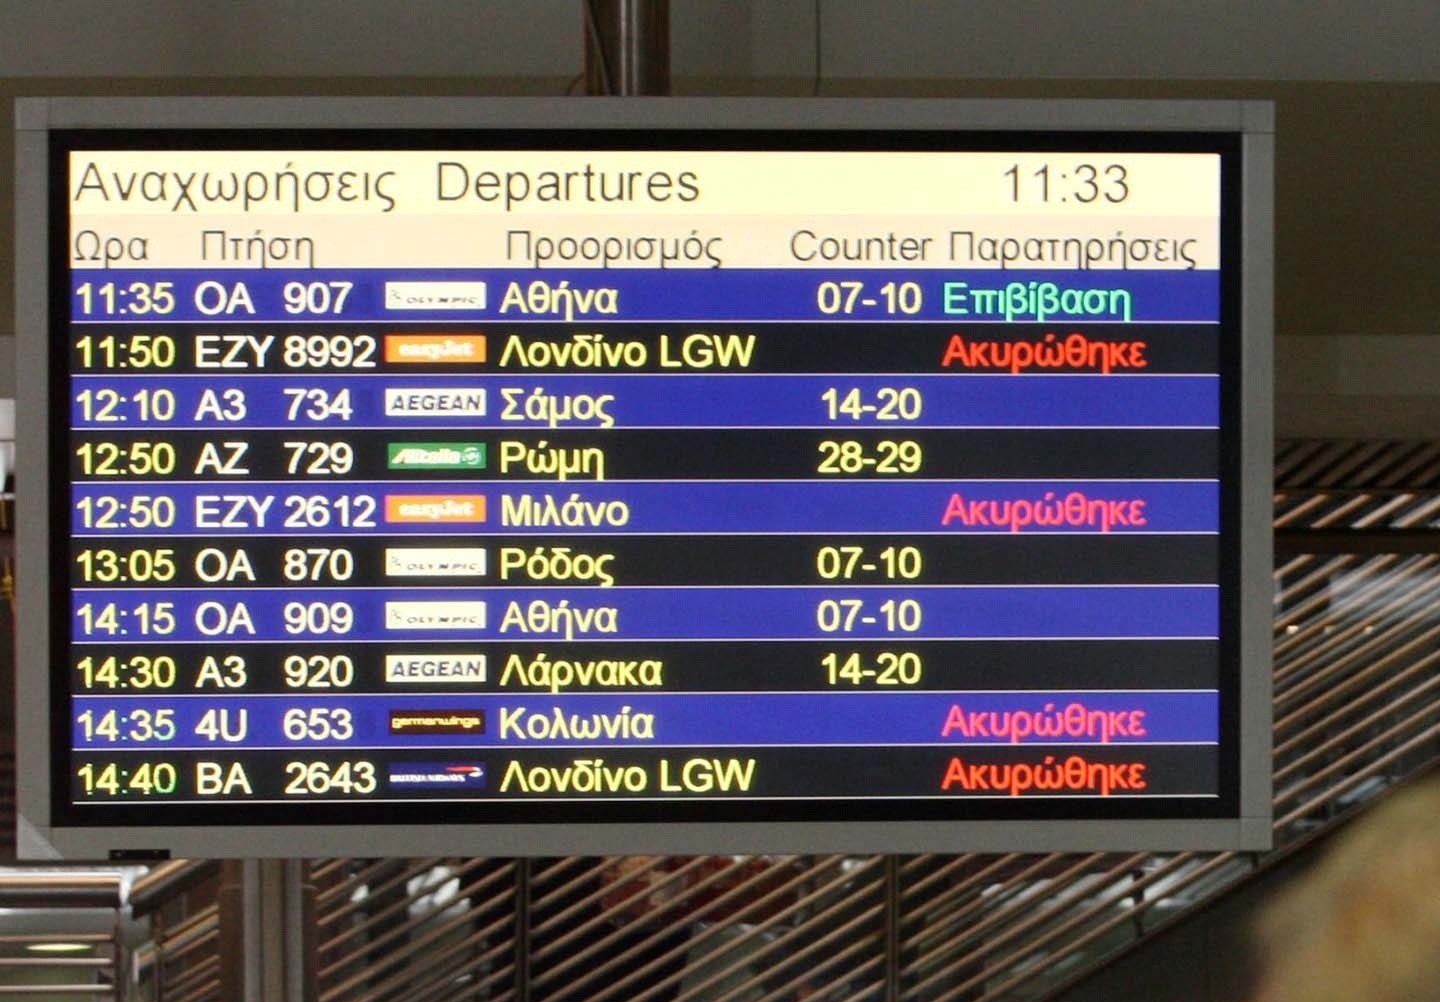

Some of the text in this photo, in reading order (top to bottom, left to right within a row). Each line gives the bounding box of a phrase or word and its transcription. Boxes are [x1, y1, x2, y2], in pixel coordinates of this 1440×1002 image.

[75, 162, 1128, 212] Αναχωρήσεις Departures 11:33
[74, 230, 1196, 267] Ωρα Πτήση Προορισμός Counter Παρατηρήσεις
[76, 280, 1131, 319] 11:35 OA 907 Αθήνα 07-10 Επιβίβαση
[76, 336, 175, 367] 11:50
[195, 335, 274, 368] EZY
[284, 335, 376, 367] 8992
[499, 334, 647, 367] Λονδίνο
[660, 334, 756, 368] LGW
[942, 334, 1146, 372] Ακυρώθηκε
[76, 387, 922, 425] 12:10 A3 734 AEGEAN Σάμος 14-20
[77, 440, 921, 478] 12:50 AZ 729 Ρώμη 28-29
[77, 496, 175, 528] 12:50
[196, 495, 274, 528] EZY
[284, 495, 376, 527] 2612
[501, 493, 629, 526] Μιλάνο
[942, 492, 1146, 531] Ακυρώθηκε
[77, 547, 921, 585] 13:05 OA 870 Ρόδος 07-10
[77, 599, 921, 638] 14:15 OA 909 Αθήνα 07-10
[77, 652, 921, 691] 14:30 A3 920 AEGEAN Λάρνακα 14-20
[77, 709, 176, 741] 14:35
[195, 709, 247, 742] 4U
[283, 708, 353, 740] 653
[500, 706, 654, 739] Κολωνία
[942, 704, 1146, 742] Ακυρώθηκε
[78, 756, 1146, 795] 14:40 BA 2643 Λονδίνο LGW Ακυρώθηκε
